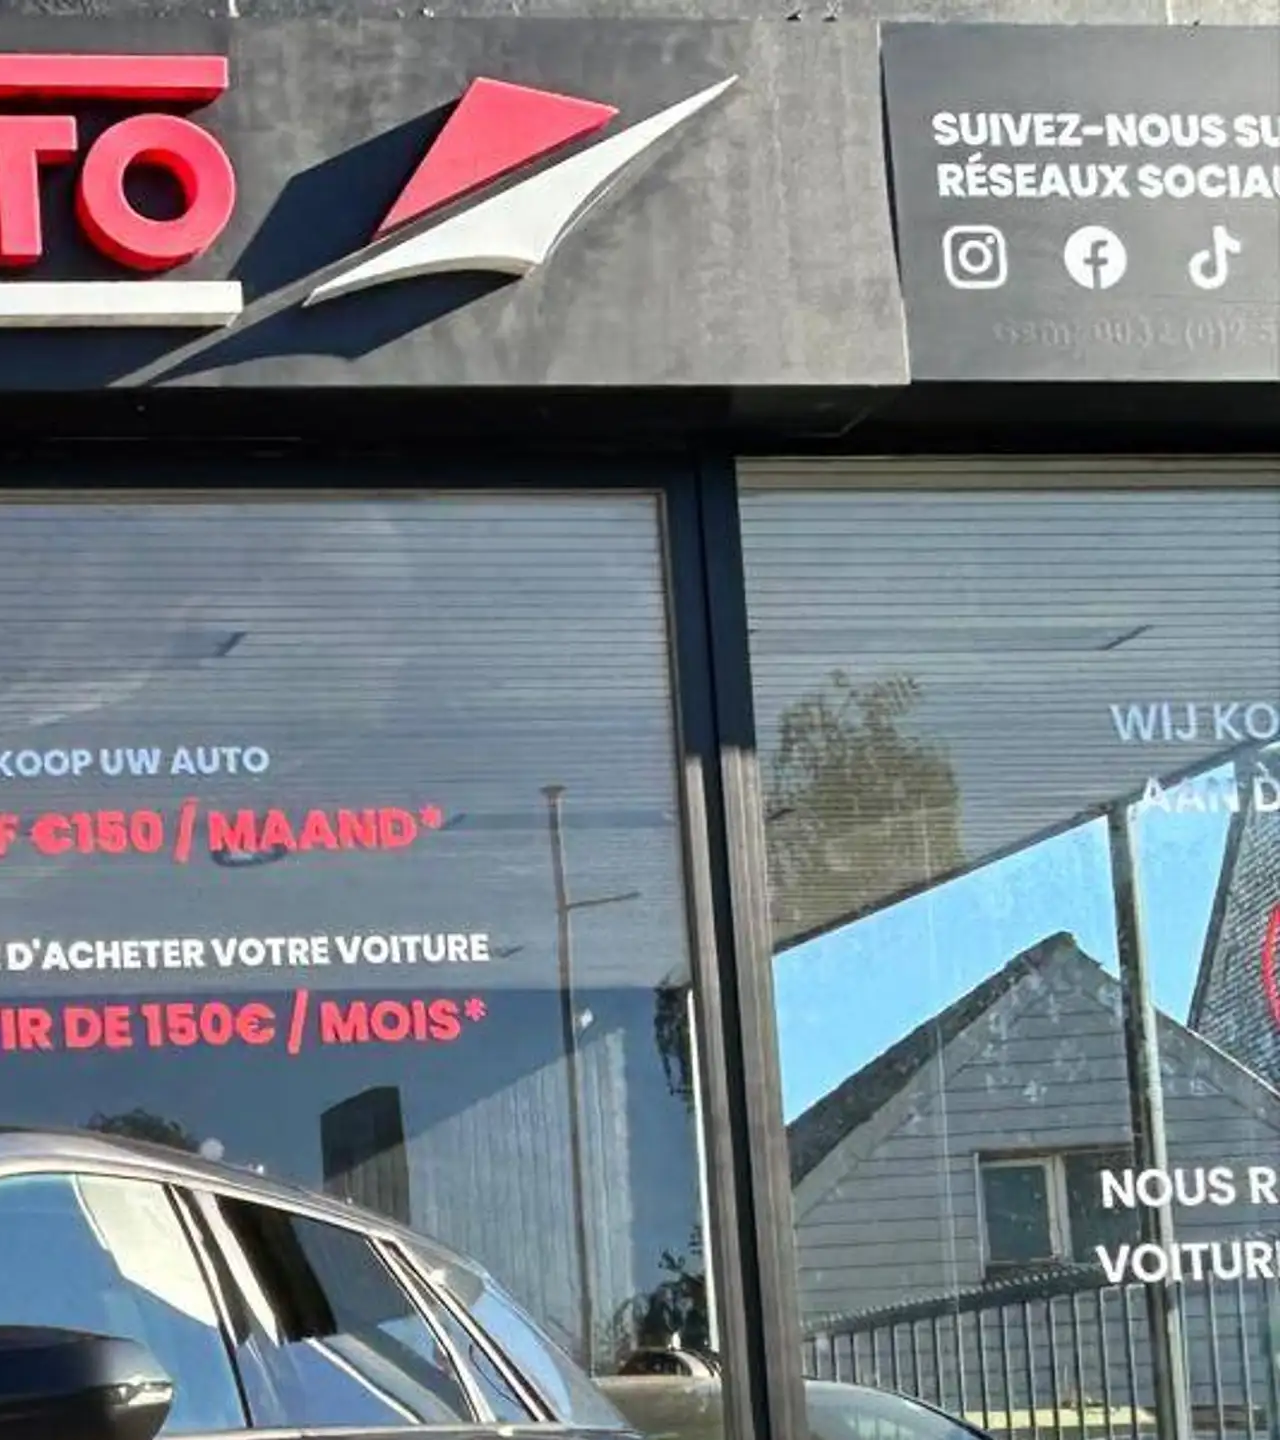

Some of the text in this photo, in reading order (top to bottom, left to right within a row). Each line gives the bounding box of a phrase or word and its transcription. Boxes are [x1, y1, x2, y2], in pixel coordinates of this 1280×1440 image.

[932, 111, 1228, 149] SUIVEZ-NOUS
[936, 151, 1131, 199] RÉSEAUX
[1108, 700, 1280, 742] WIJ KO
[100, 748, 162, 777] UW
[170, 746, 271, 777] AUTO
[1141, 775, 1240, 814] AAN
[31, 809, 164, 856] €150
[172, 797, 198, 865] /
[7, 937, 203, 973] D'ACHETER
[210, 936, 330, 969] VOTRE
[334, 933, 490, 966] VOITURE
[65, 1002, 133, 1050] DE
[140, 1001, 275, 1049] 150€
[286, 988, 309, 1055] /
[1100, 1166, 1237, 1210] NOUS
